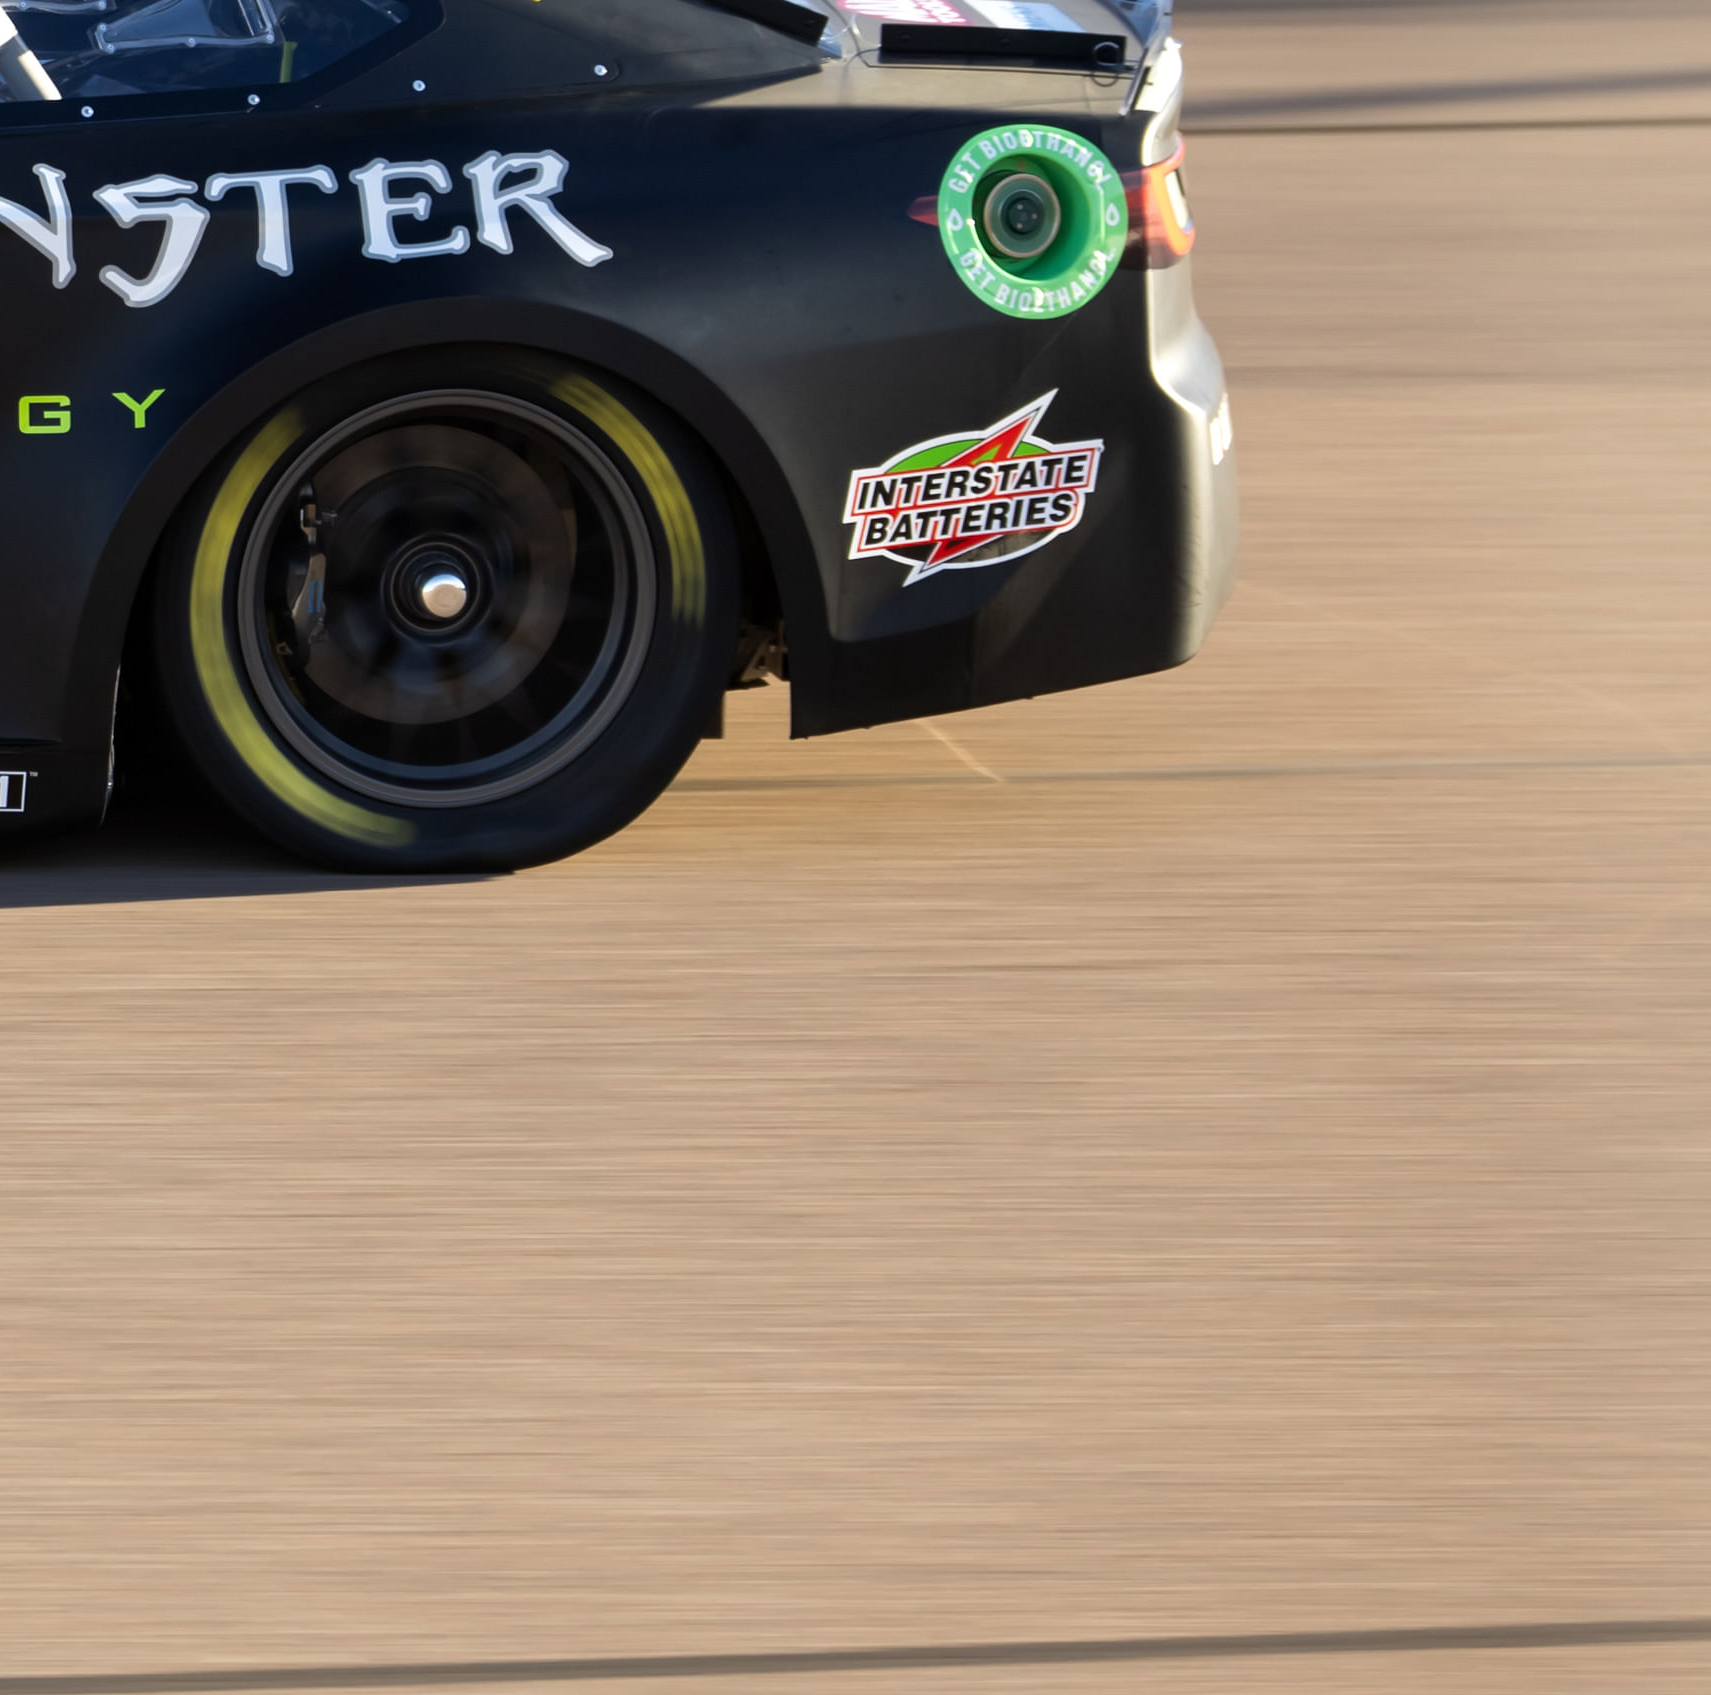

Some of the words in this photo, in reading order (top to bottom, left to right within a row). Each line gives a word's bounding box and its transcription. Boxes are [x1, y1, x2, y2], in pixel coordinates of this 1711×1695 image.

[948, 151, 981, 194] GET
[960, 247, 996, 290] GET
[858, 453, 1091, 511] INTERSTATE
[864, 492, 1074, 546] BATTERIES
